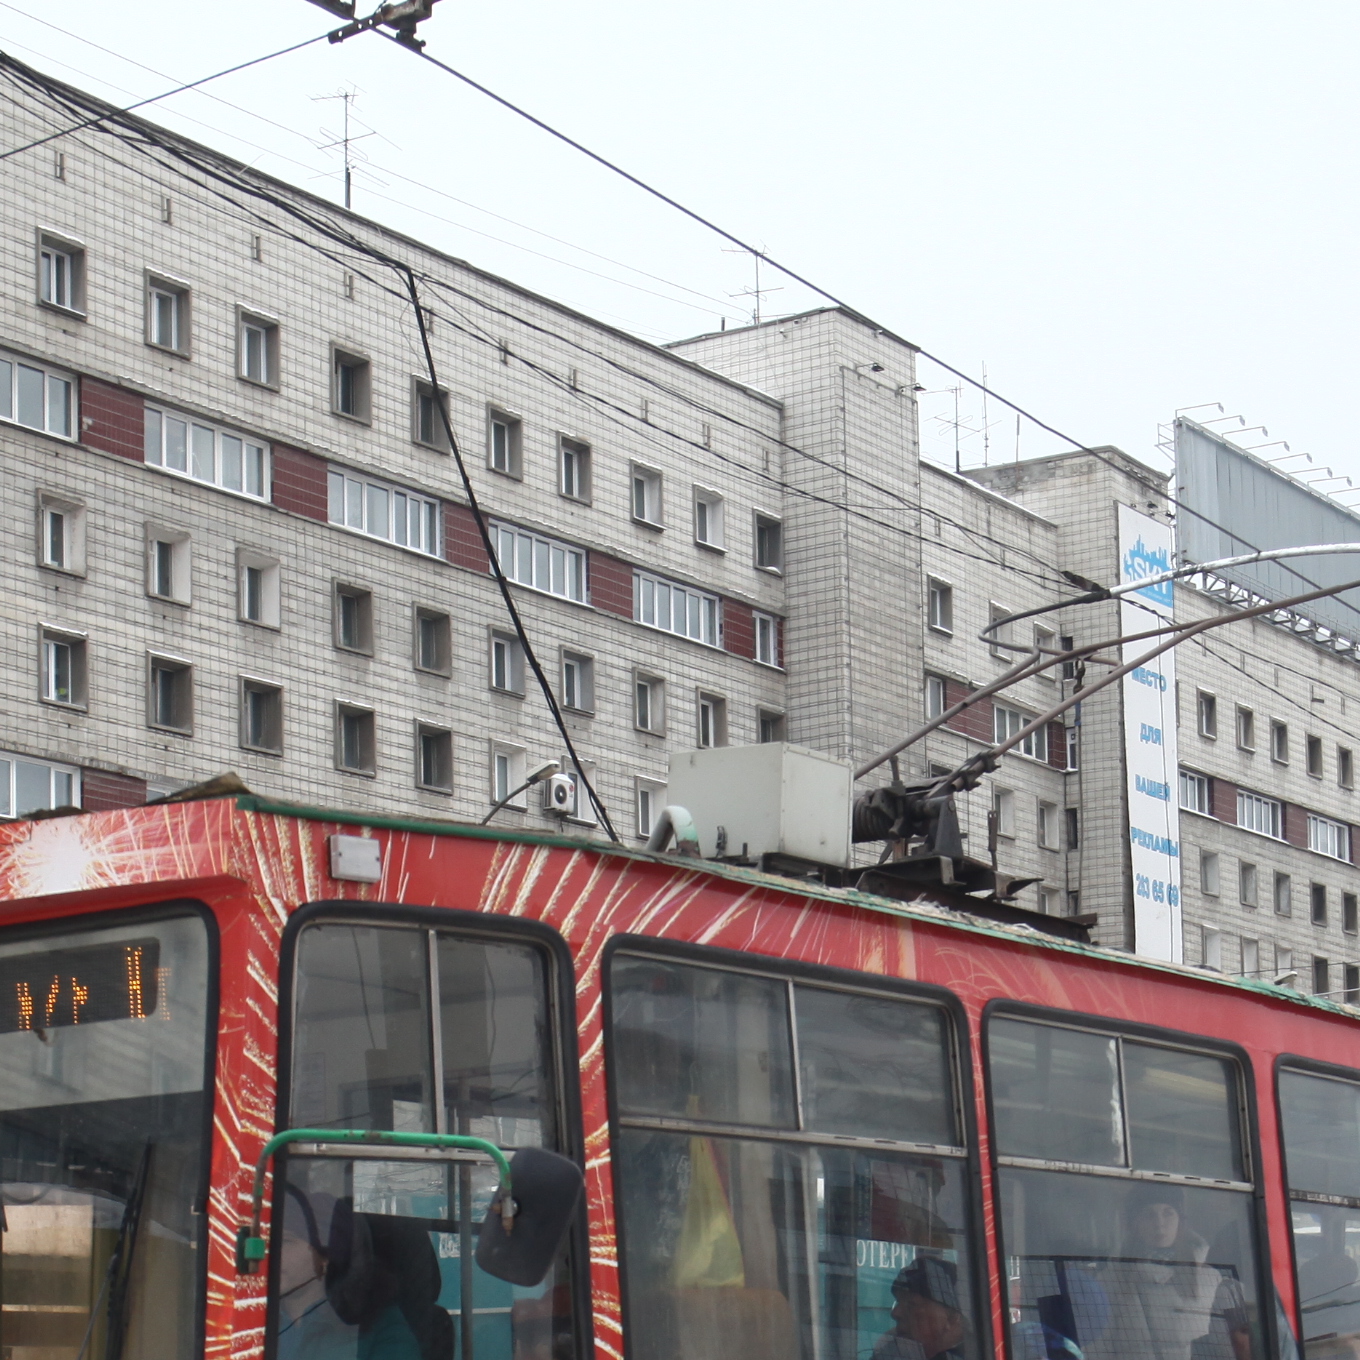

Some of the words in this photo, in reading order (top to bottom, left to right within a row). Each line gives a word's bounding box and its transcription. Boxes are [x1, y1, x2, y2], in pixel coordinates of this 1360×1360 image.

[1131, 666, 1167, 692] МЕСТО
[1140, 722, 1162, 746] ДЛЯ
[1130, 826, 1179, 858] РЕКЛАМЫ
